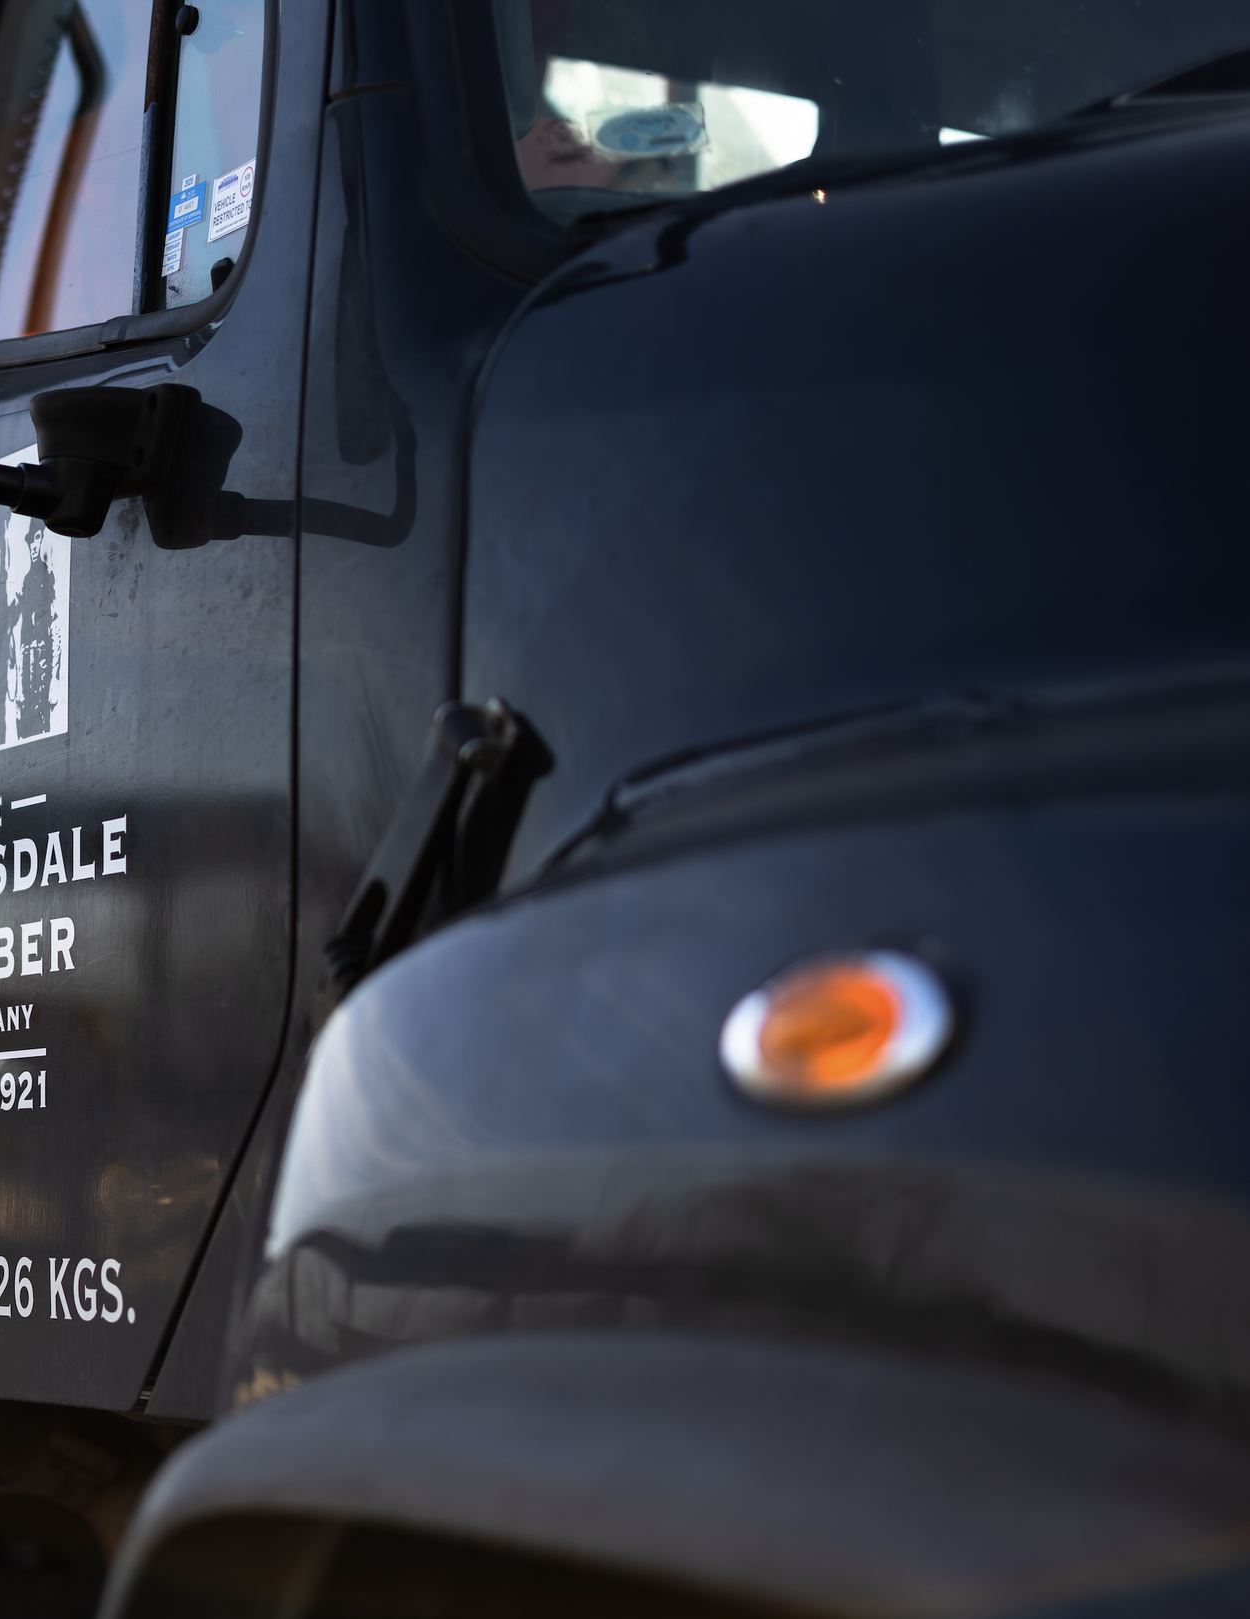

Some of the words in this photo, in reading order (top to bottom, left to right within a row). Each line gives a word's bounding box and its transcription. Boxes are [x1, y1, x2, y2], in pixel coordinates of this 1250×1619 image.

[214, 192, 236, 213] VEHICLE
[212, 202, 244, 228] RESTRICTED
[167, 253, 177, 262] MARCH
[48, 1257, 137, 1324] KGS.
